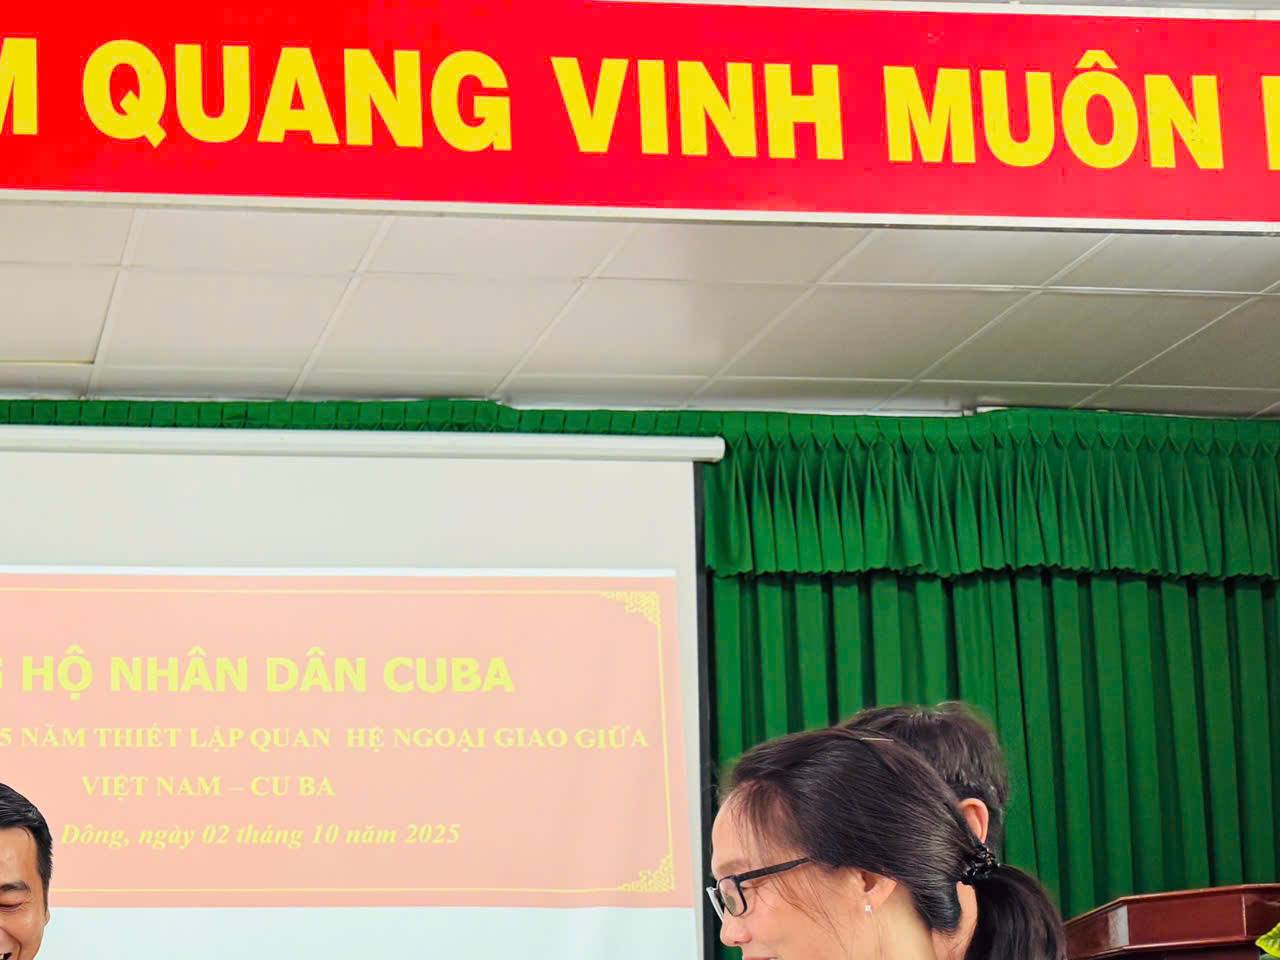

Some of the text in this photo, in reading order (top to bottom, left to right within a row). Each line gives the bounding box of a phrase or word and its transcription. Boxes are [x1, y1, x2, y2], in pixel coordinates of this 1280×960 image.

[82, 39, 513, 152] QUANG
[550, 56, 844, 161] VINH
[883, 49, 1225, 170] MUÔN
[22, 644, 93, 700] HỘ
[110, 645, 248, 693] NHÂN
[266, 646, 368, 694] DÂN
[382, 656, 516, 694] CUBA
[20, 722, 87, 748] NĂM
[93, 721, 183, 748] THIẾT
[189, 725, 246, 752] LẬP
[249, 727, 332, 752] QUAN
[346, 725, 386, 752] HỆ
[392, 727, 488, 752] NGOẠI
[493, 727, 569, 749] GIAO
[574, 722, 650, 749] GIỮA
[81, 775, 149, 802] VIỆT
[156, 775, 222, 797] NAM
[250, 775, 291, 797] CU
[298, 775, 337, 797] BA
[138, 824, 196, 849] ngày
[202, 824, 231, 845] 02
[236, 823, 305, 848] tháng
[312, 823, 340, 845] 10
[345, 825, 398, 845] năm
[404, 822, 462, 844] 2025
